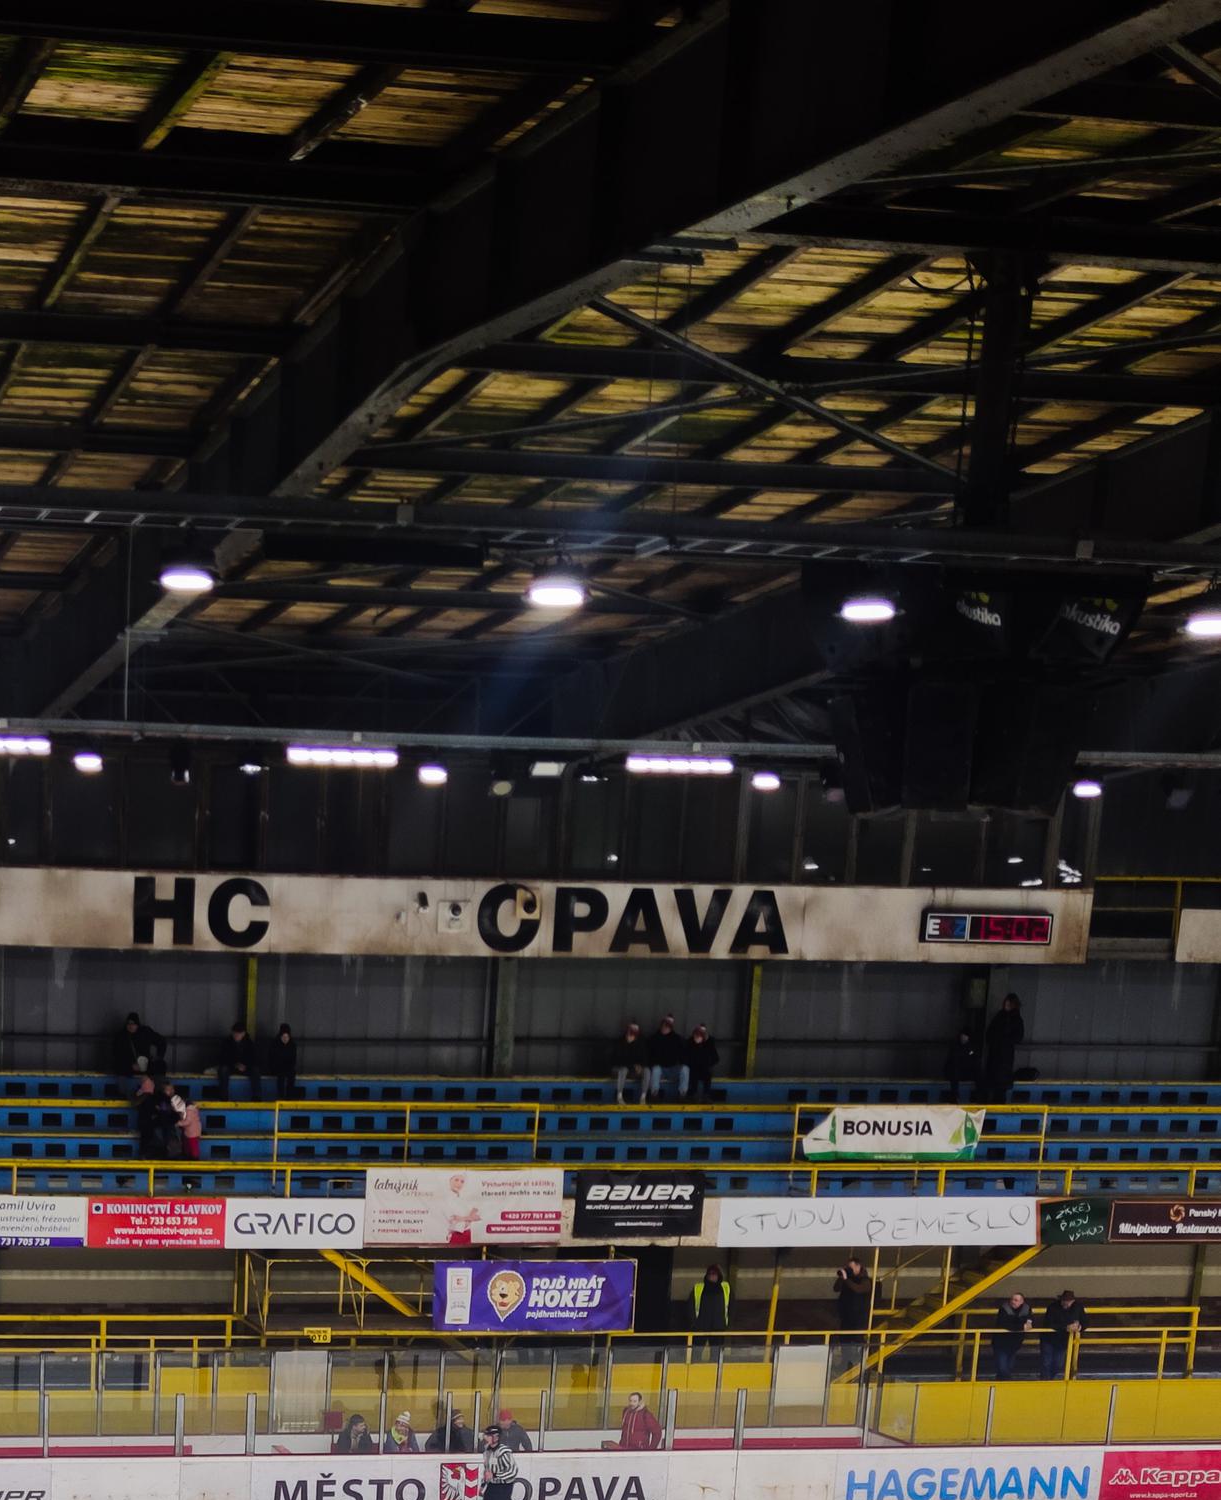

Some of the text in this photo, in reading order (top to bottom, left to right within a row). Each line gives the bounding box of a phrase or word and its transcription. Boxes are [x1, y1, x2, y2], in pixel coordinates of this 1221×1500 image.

[133, 876, 788, 954] HC OPAVA
[843, 1120, 933, 1136] BONUSIA
[586, 1185, 695, 1200] BAUER
[107, 1202, 222, 1214] KOMINICTVÍ SLAVKOV
[131, 1217, 147, 1225] Tel.:
[150, 1217, 164, 1225] 733
[234, 1213, 356, 1235] GRAFICO
[734, 1204, 1030, 1243] STUDUJ ŘEMESLO
[114, 1227, 213, 1236] www.kominictvi-opava.cz
[1, 1238, 50, 1246] 731 705 734
[533, 1275, 606, 1289] POJĎ HRÁT
[528, 1289, 601, 1308] HOKEJ
[526, 1309, 587, 1319] pojdhrathokej.cz
[1140, 1468, 1221, 1487] Kappa
